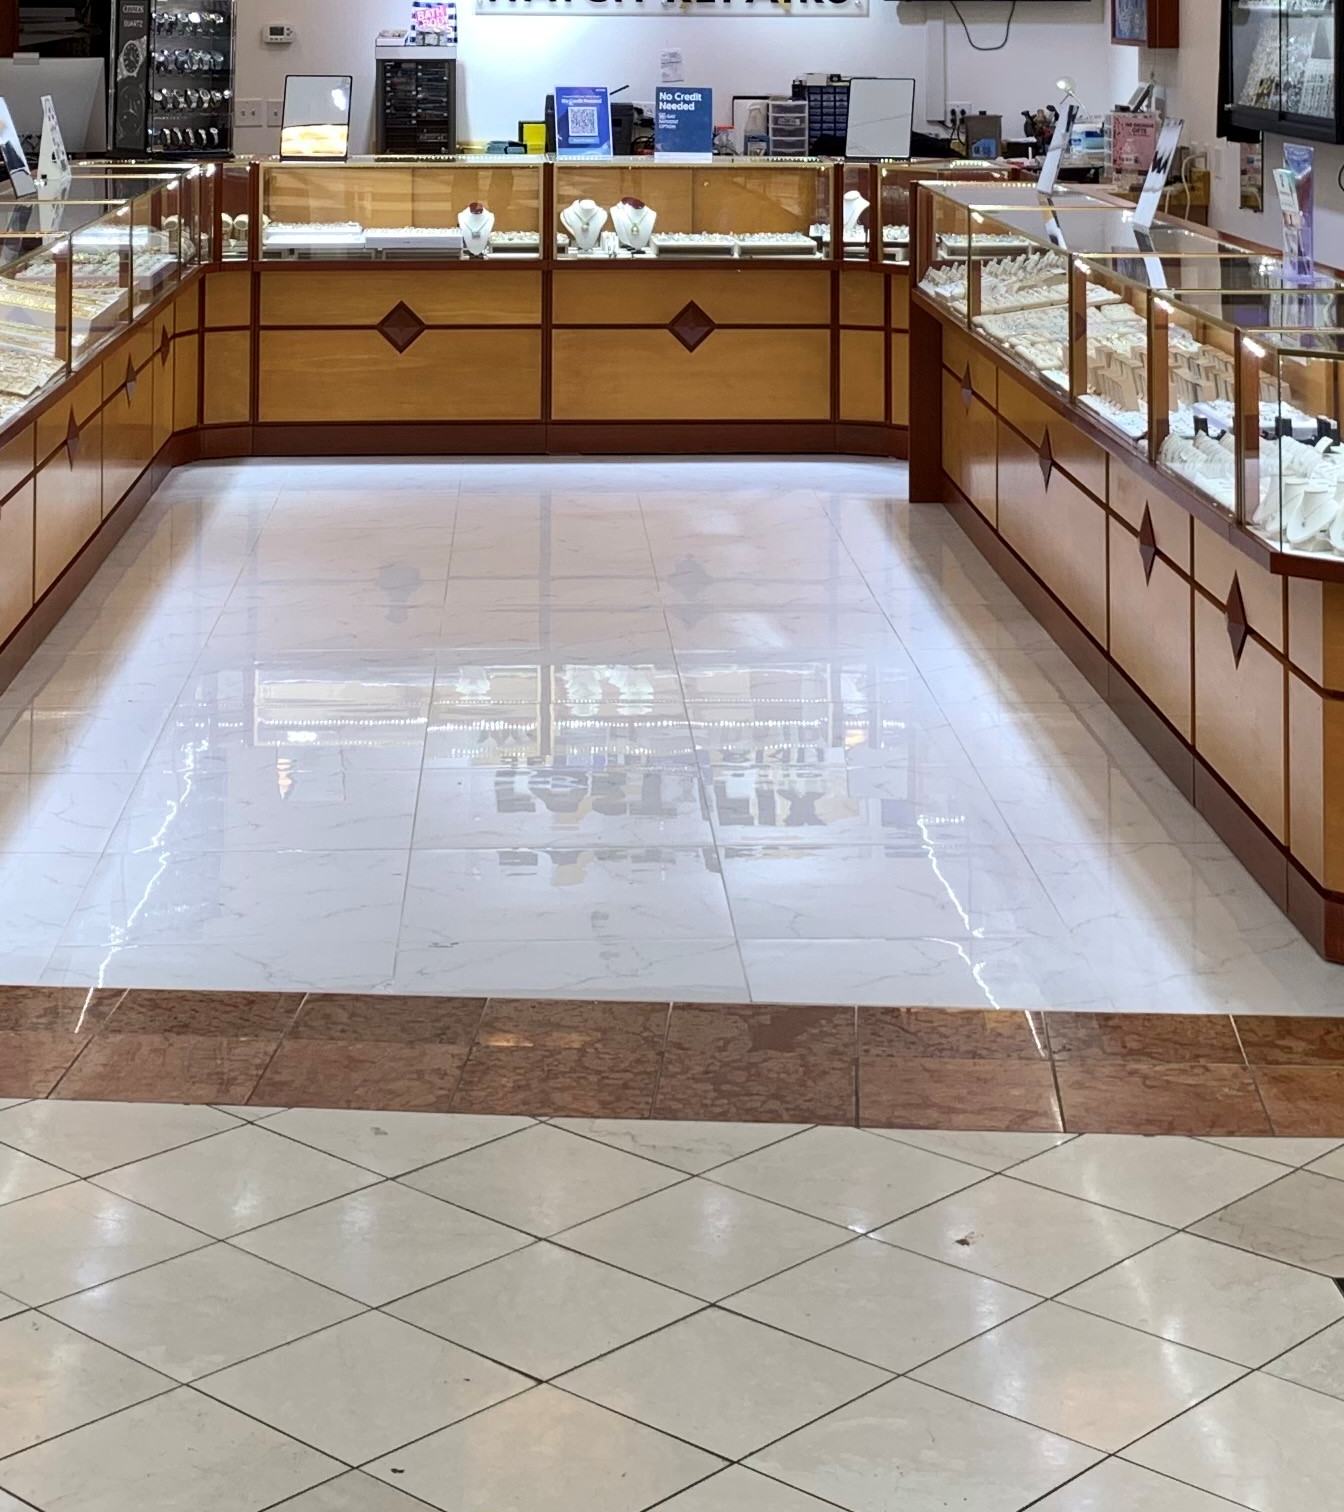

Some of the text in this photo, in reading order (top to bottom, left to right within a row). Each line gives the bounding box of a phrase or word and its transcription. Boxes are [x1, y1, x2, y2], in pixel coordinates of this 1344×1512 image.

[659, 92, 702, 102] No Credit
[659, 102, 695, 111] Needed
